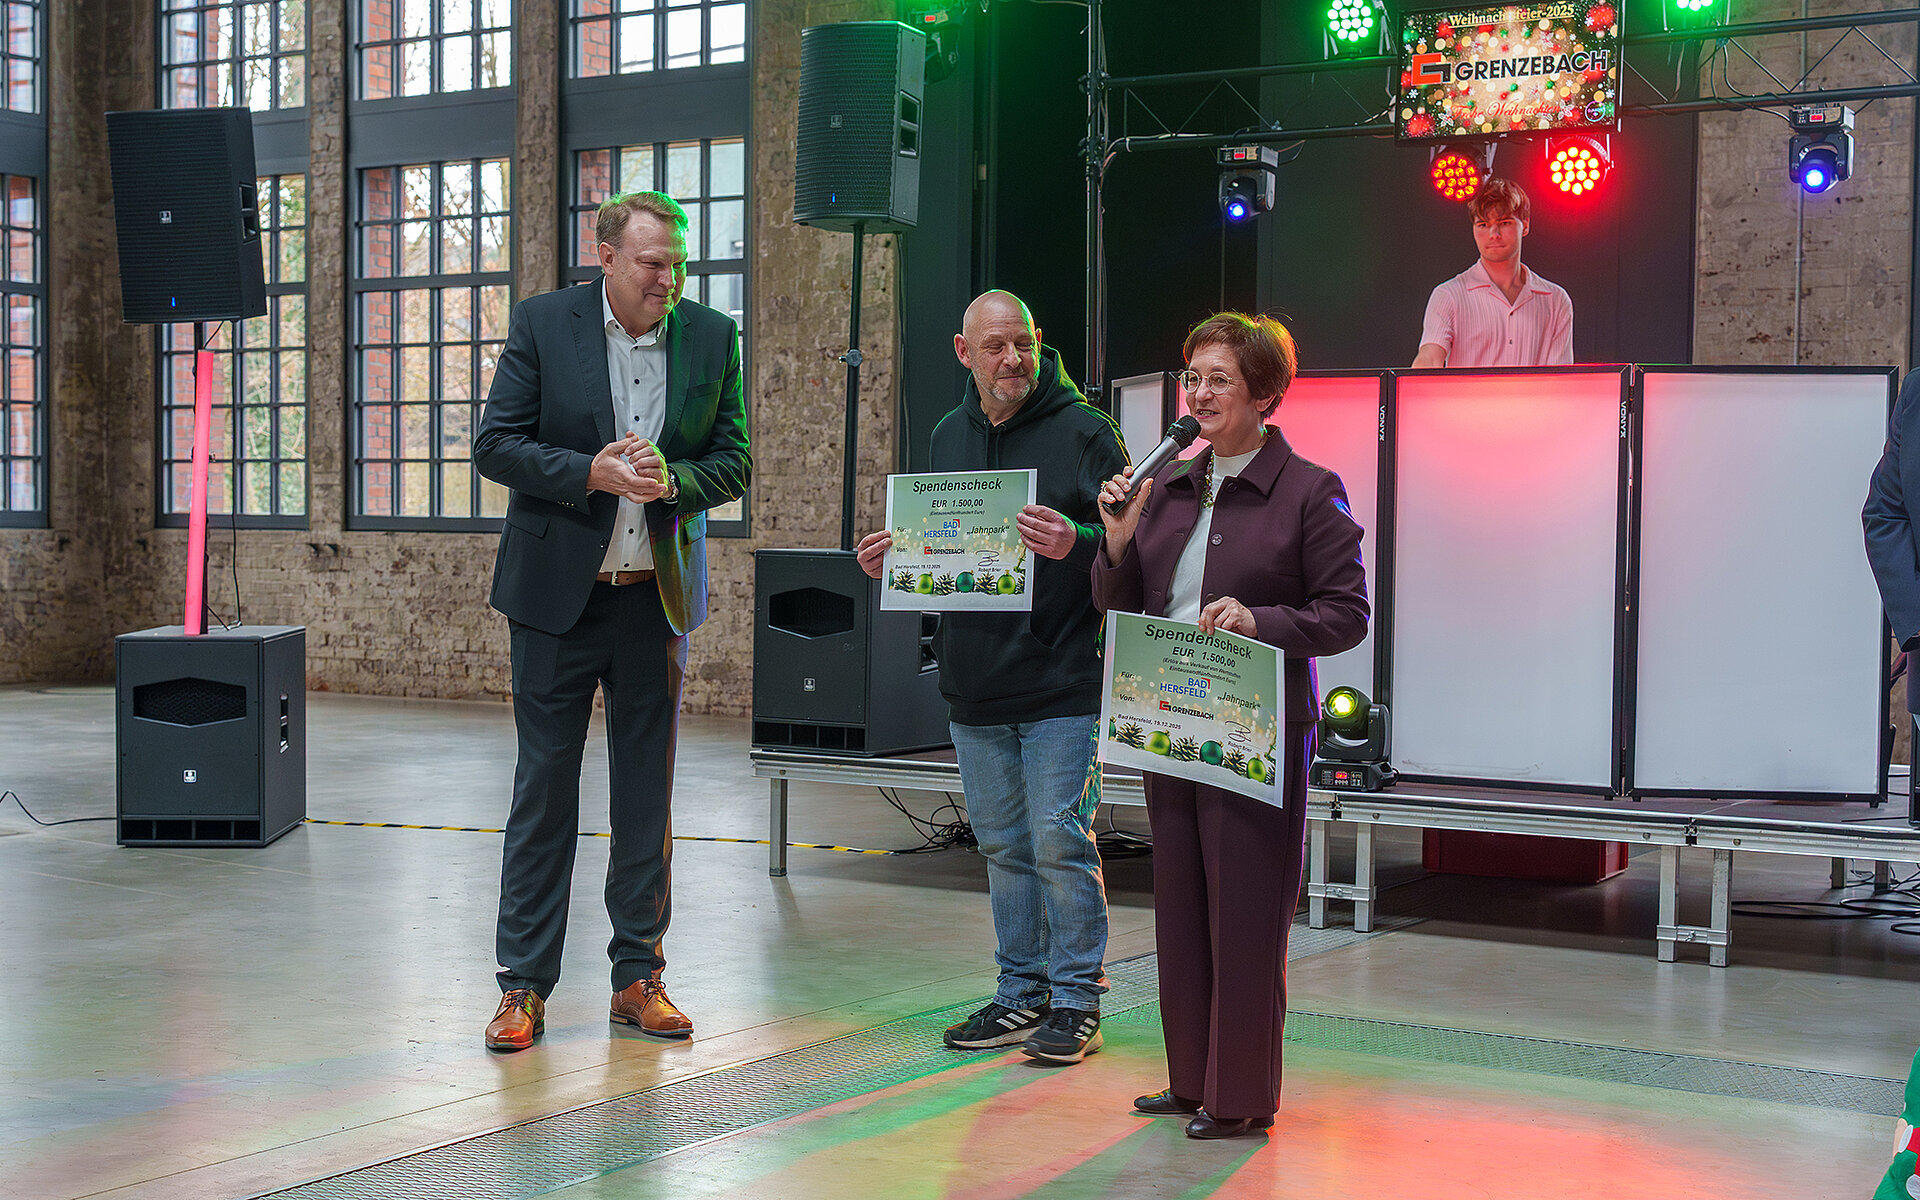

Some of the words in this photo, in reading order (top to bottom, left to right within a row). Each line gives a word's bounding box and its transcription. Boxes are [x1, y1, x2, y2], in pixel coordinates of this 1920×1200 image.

[1448, 4, 1575, 26] Weihnachfeier-2025
[1454, 49, 1608, 81] GRENZEBACH
[1487, 99, 1561, 119] Weihnachten
[912, 478, 1002, 494] Spendenscheck
[931, 500, 948, 508] EUR
[952, 499, 984, 508] 1.500,00
[924, 530, 958, 538] HERSFELD
[943, 521, 958, 529] BAD
[1144, 624, 1253, 660] Spendenscheck
[1172, 646, 1195, 658] EUR
[1202, 651, 1236, 668] 1.500,00
[1120, 671, 1136, 680] Für:
[1159, 682, 1207, 699] HERSFELD
[1187, 677, 1208, 689] BAD
[1119, 693, 1136, 702] Von:
[1171, 705, 1215, 721] GRENZEBACH
[1117, 713, 1128, 721] Bad
[1153, 720, 1182, 730] 19.12.2025
